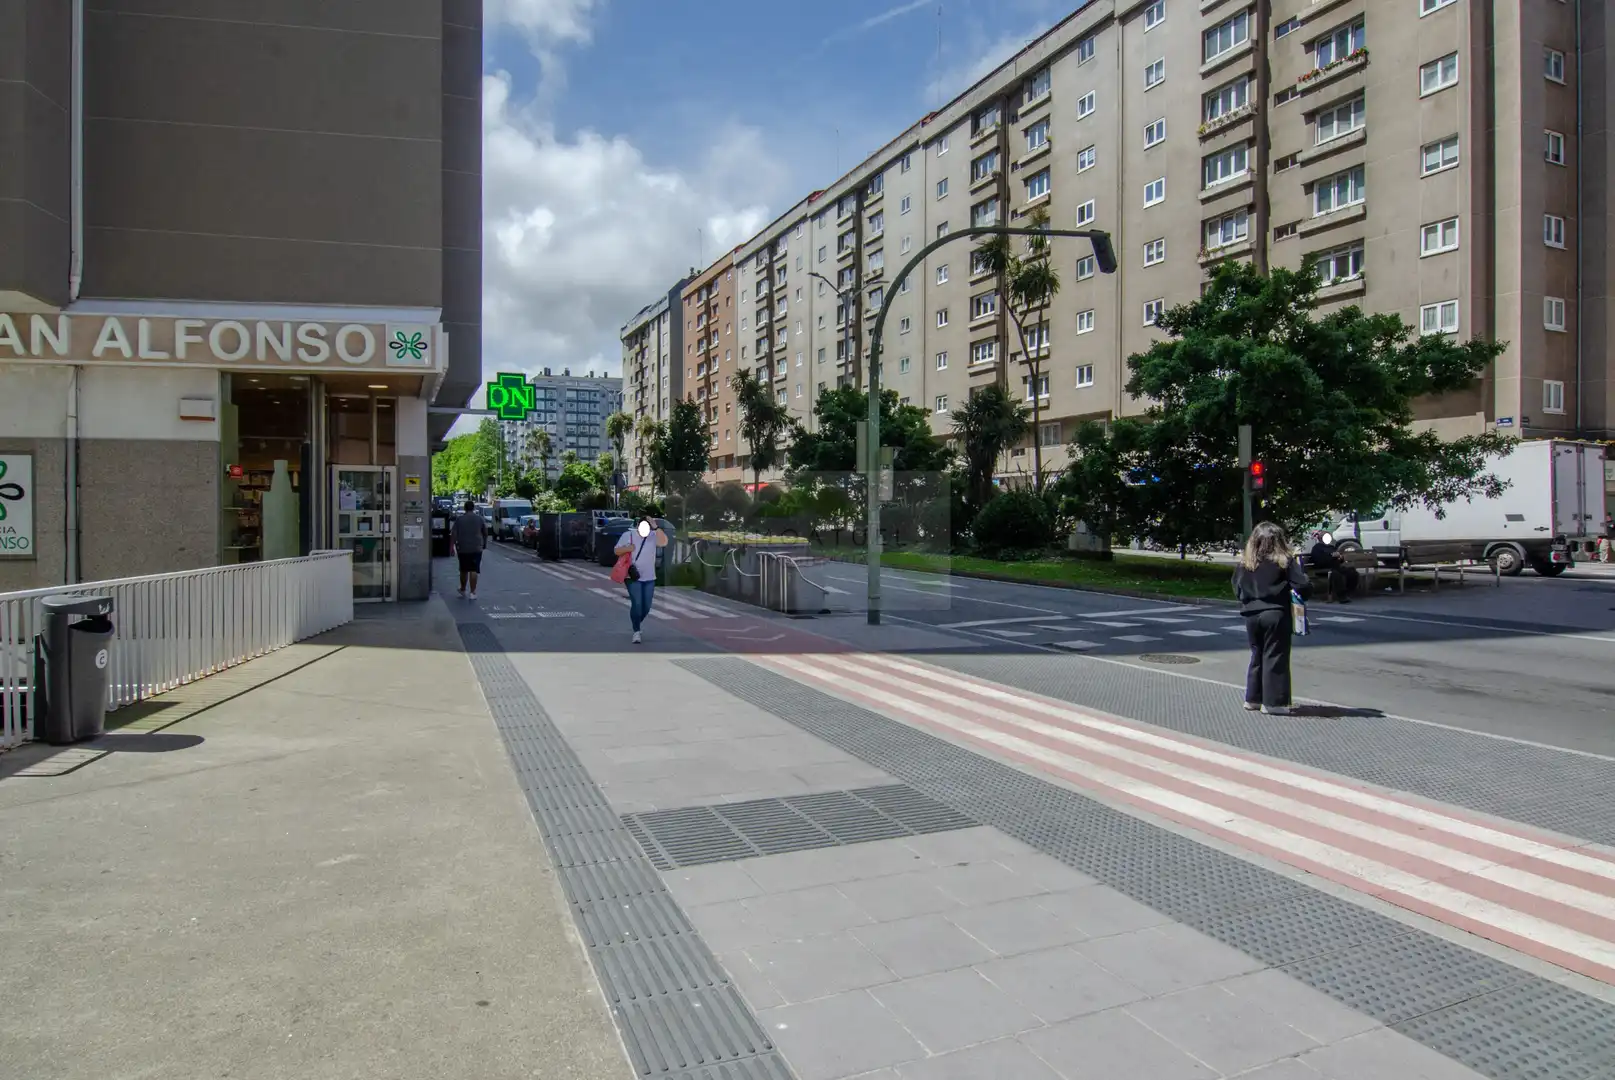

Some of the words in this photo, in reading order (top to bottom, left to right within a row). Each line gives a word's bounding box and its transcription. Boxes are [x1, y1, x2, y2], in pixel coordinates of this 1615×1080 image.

[92, 316, 376, 364] ALFONSO
[490, 386, 530, 408] ON
[0, 526, 17, 534] IA
